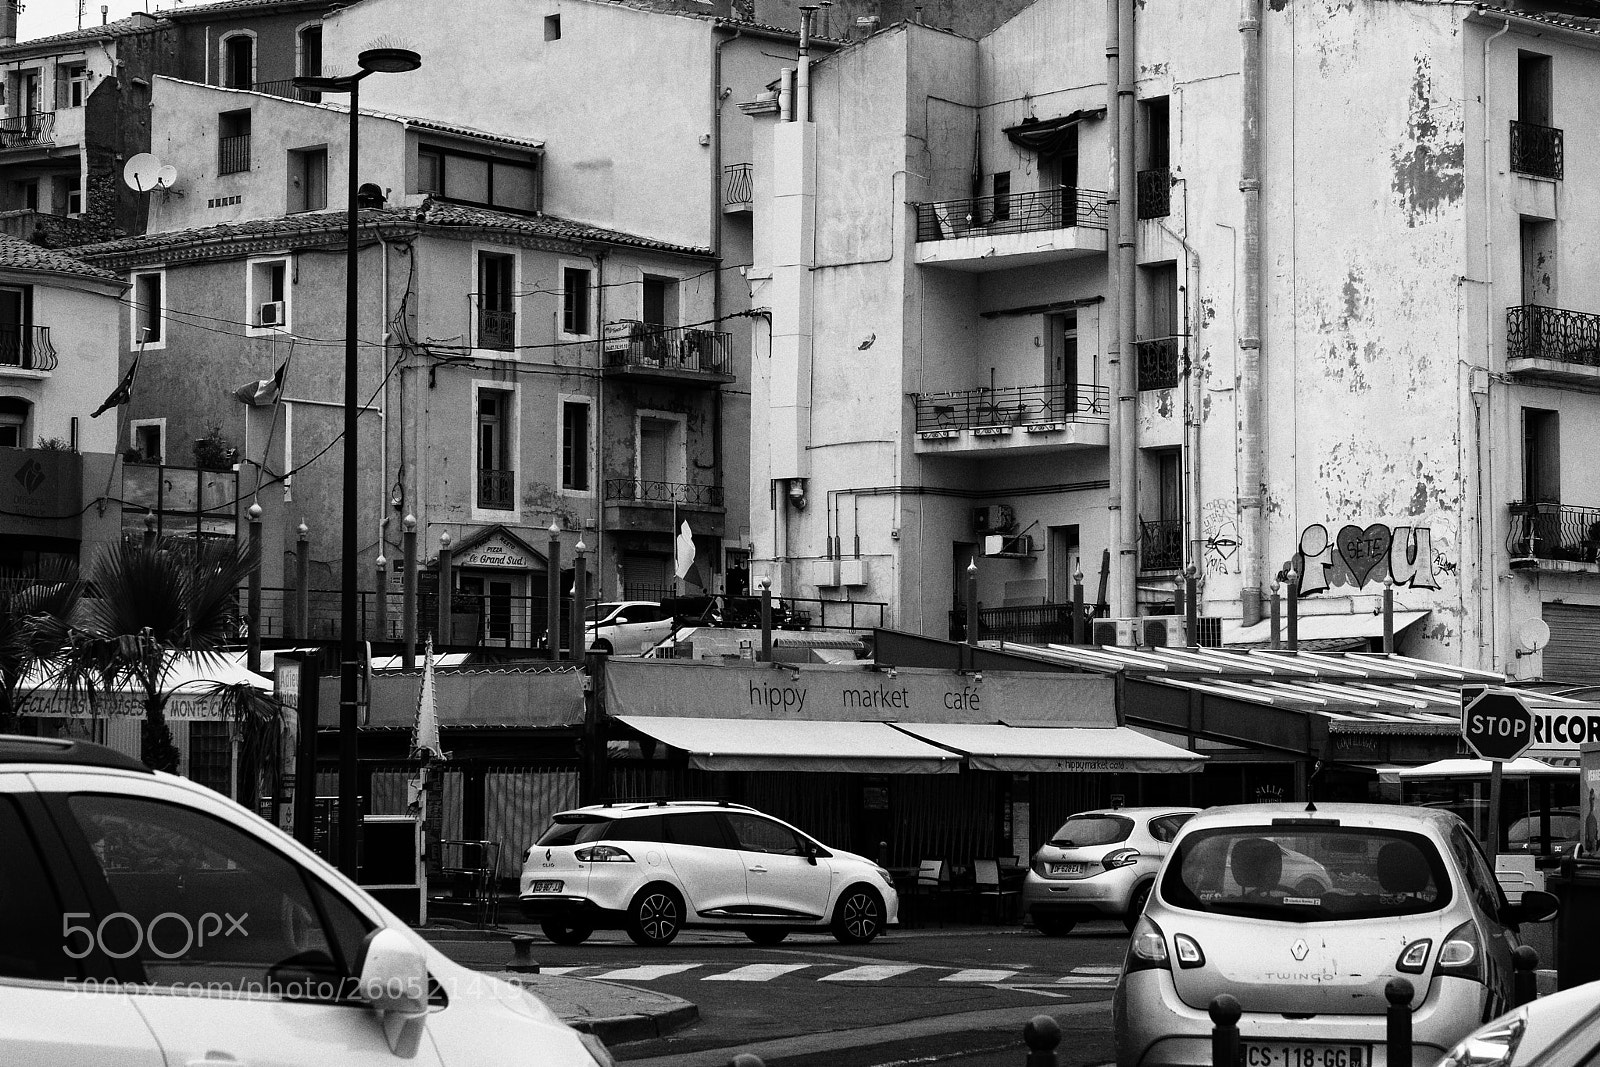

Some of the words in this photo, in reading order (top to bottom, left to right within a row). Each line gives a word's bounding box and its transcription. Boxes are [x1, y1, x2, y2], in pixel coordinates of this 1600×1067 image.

[480, 555, 506, 565] Grand
[507, 556, 524, 567] Sud
[749, 680, 807, 712] hippy
[843, 684, 909, 709] market
[944, 686, 980, 711] café
[170, 700, 208, 718] MONTE
[1471, 715, 1527, 738] STOP
[1264, 972, 1334, 981] TWINGO
[1248, 1046, 1347, 1067] CS-118-GG
